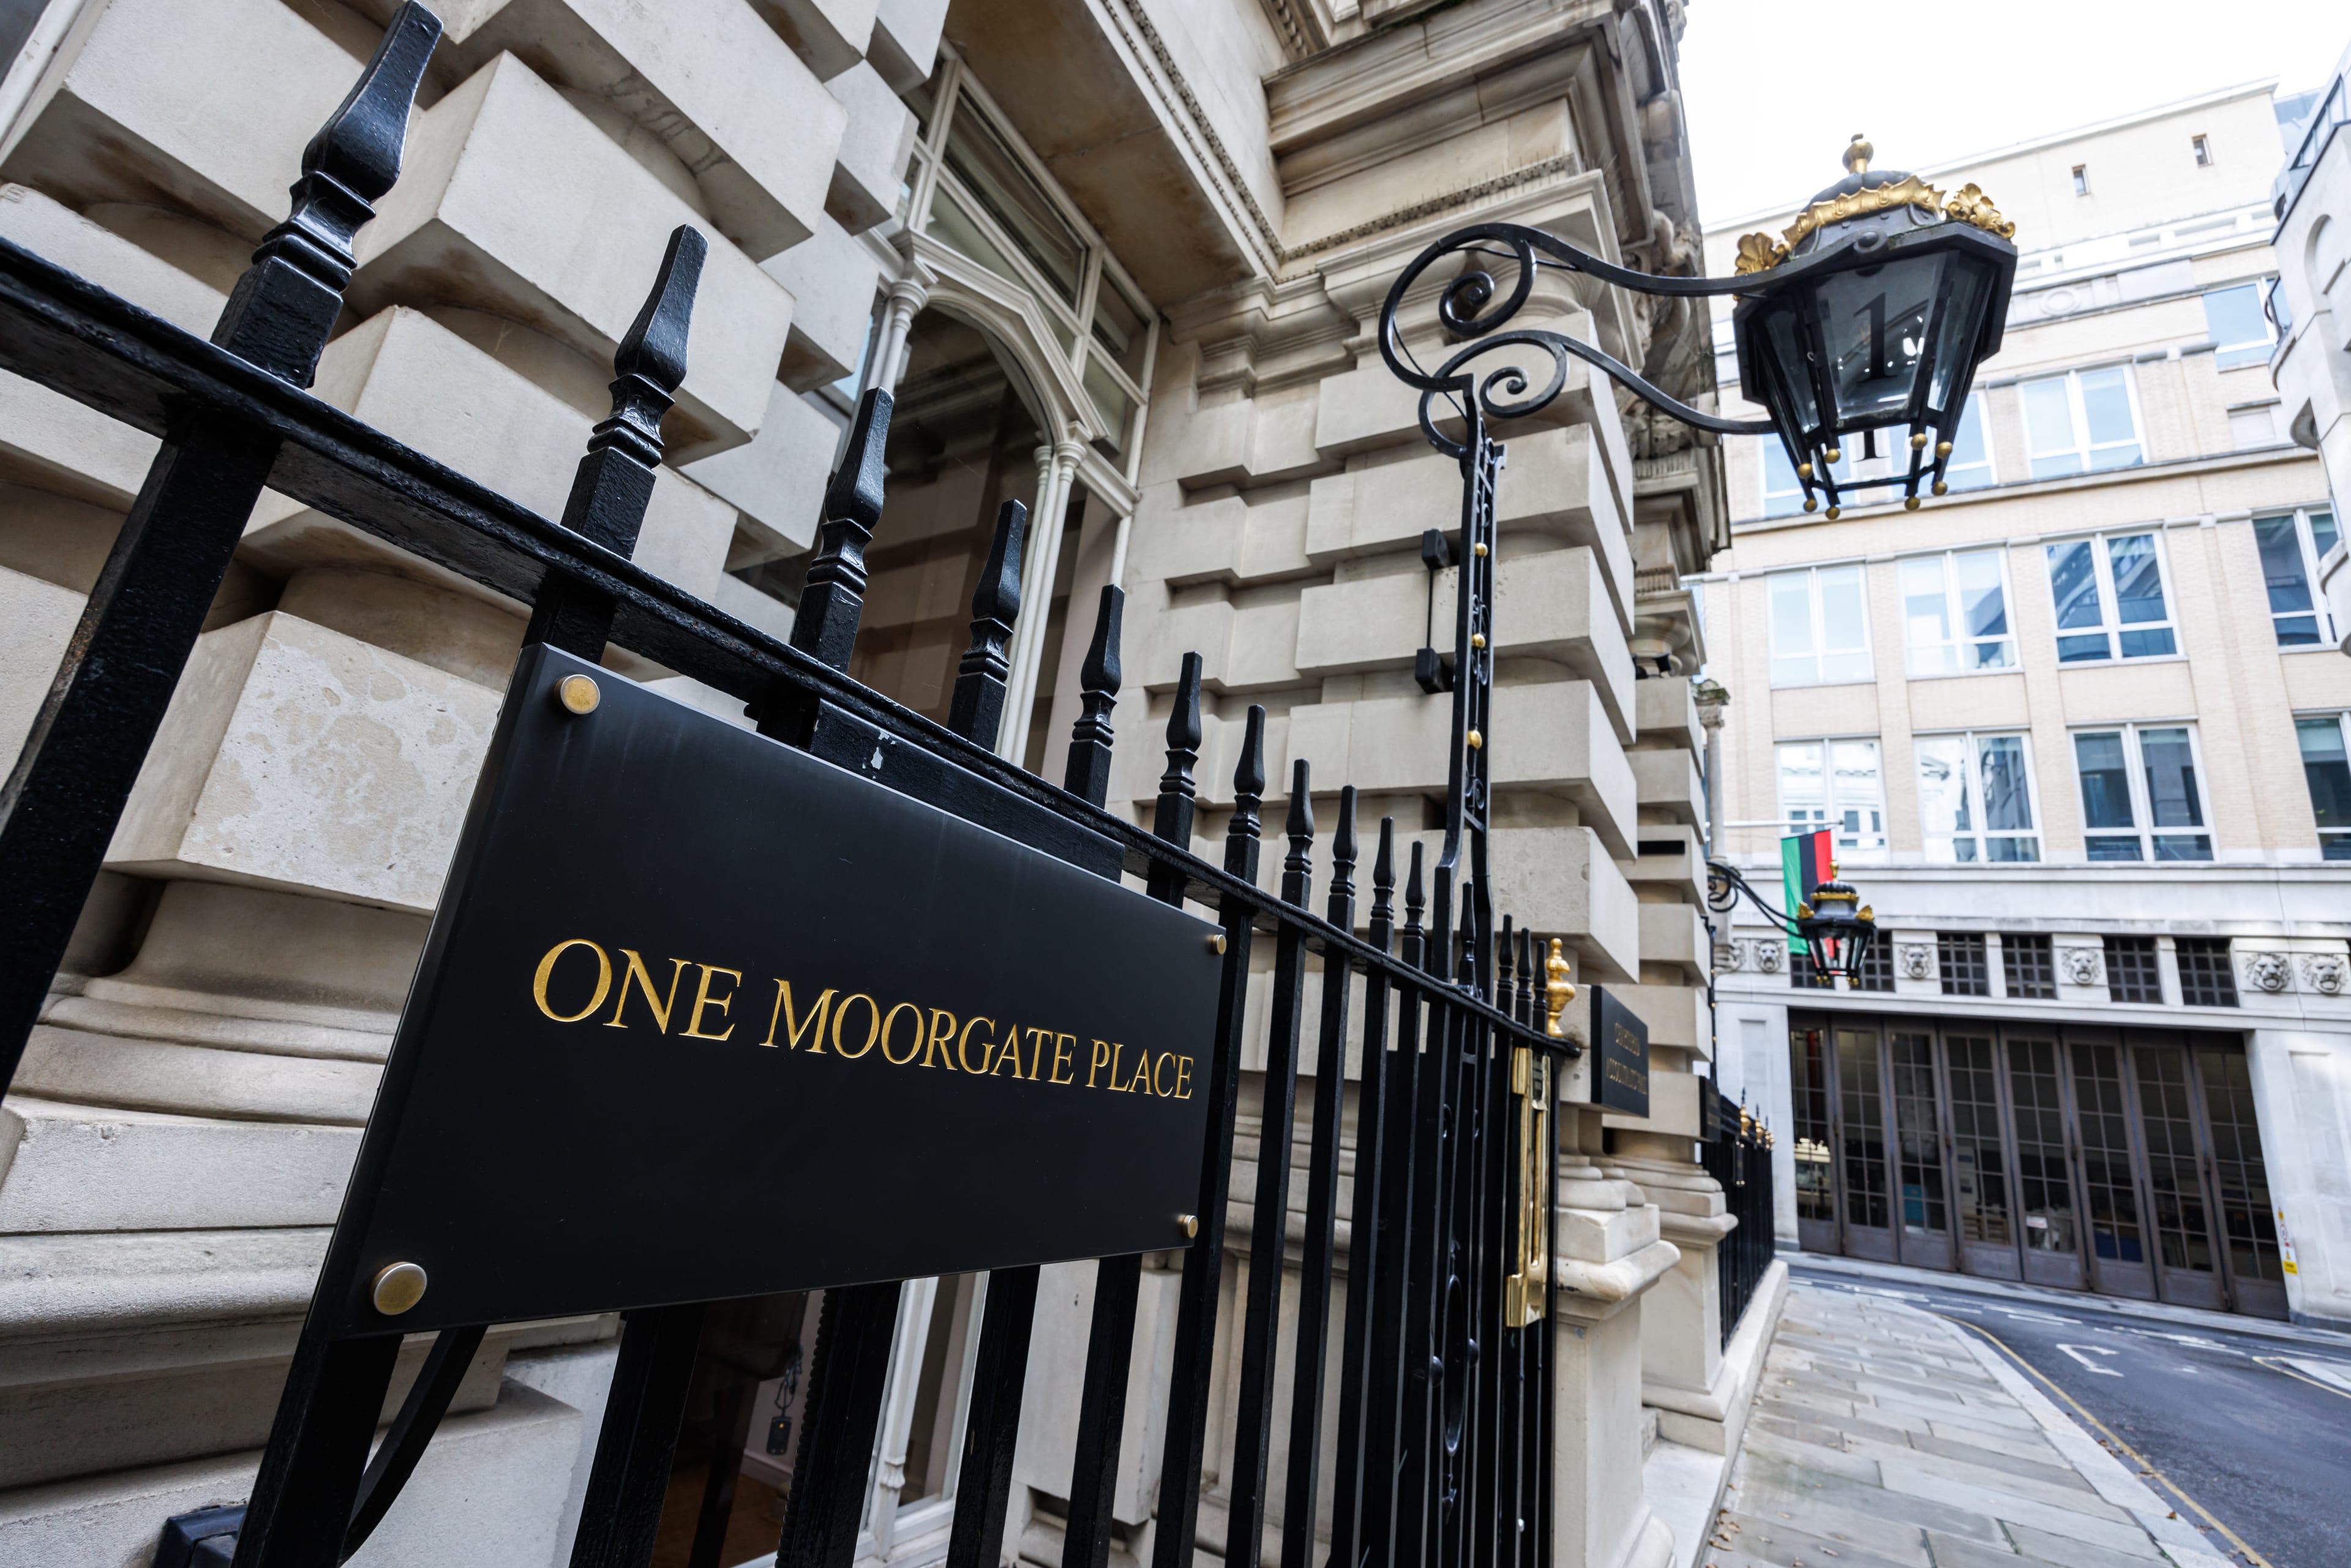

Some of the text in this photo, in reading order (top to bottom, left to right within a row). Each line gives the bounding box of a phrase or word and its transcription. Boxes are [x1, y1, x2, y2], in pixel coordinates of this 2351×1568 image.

[1852, 292, 1897, 383] 1
[533, 938, 1194, 1099] ONE MOORGATE PLACE
